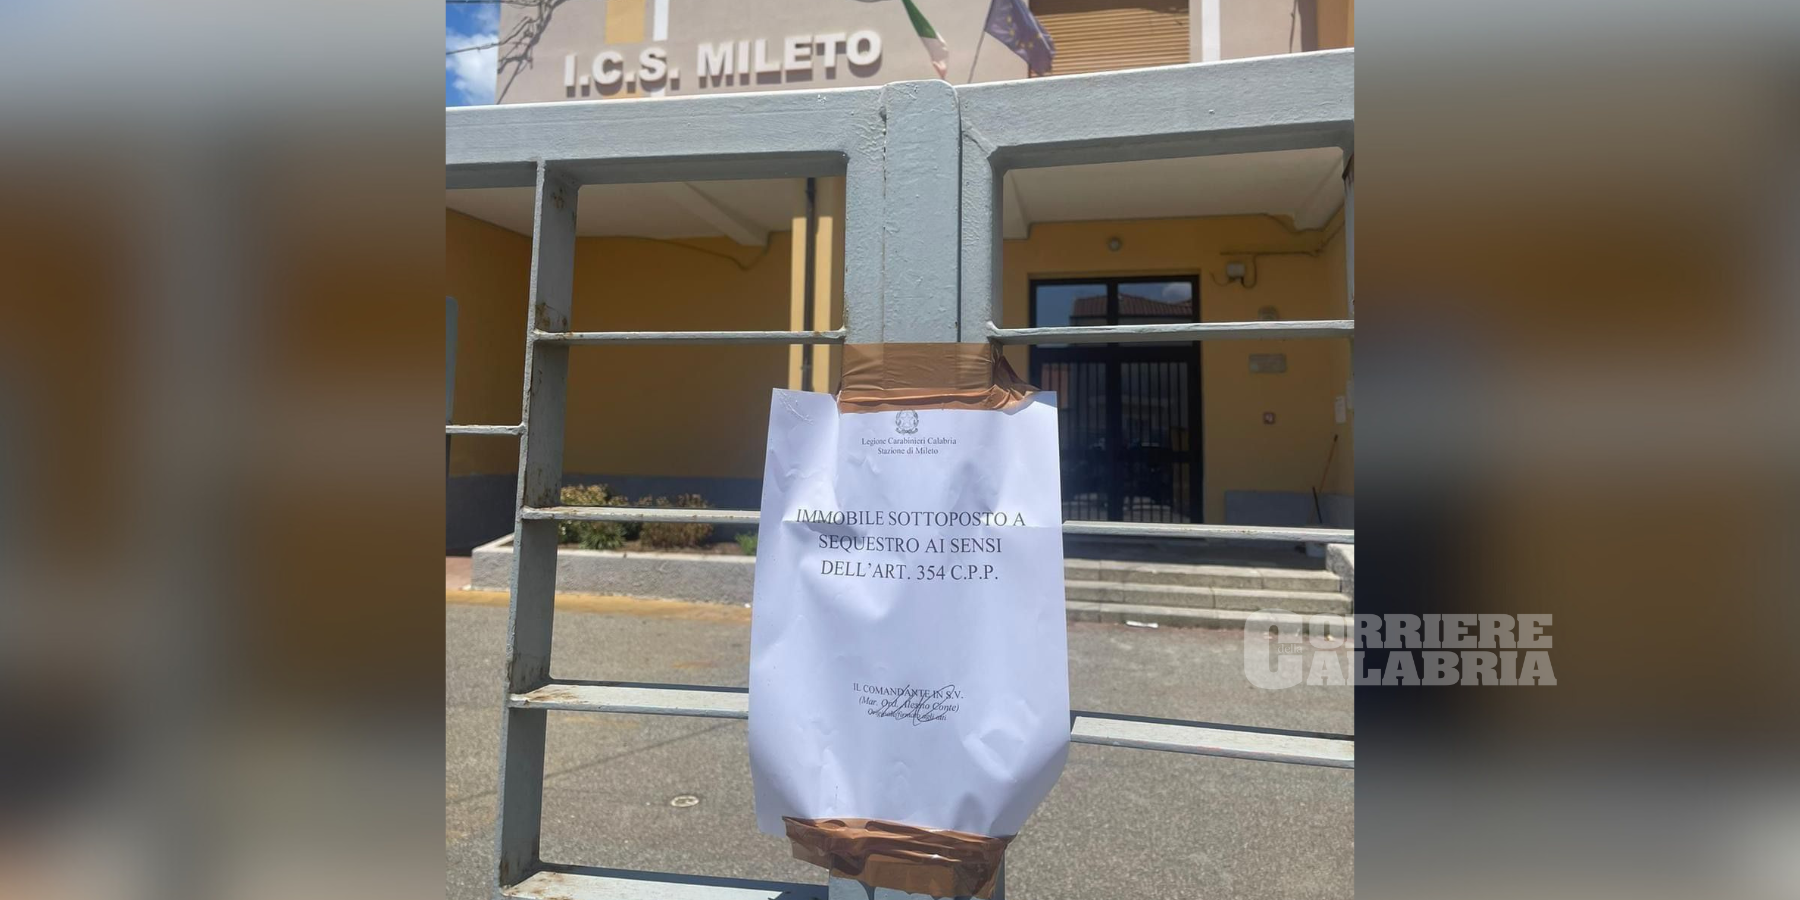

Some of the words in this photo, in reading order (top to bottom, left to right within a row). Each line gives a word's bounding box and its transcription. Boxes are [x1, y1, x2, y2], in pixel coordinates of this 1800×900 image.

[564, 47, 680, 87] I.C.S.
[697, 30, 882, 78] MILETO
[861, 437, 886, 446] Legione
[887, 437, 926, 445] Carabinieri
[927, 437, 957, 445] Calabria
[877, 447, 905, 455] Stazione
[906, 447, 914, 455] di
[915, 447, 939, 455] Mileto
[796, 508, 885, 526] IMMOBILE
[888, 510, 1008, 527] SOTTOPOSTO
[1012, 512, 1026, 527] A
[818, 534, 920, 553] SEQUESTRO
[924, 538, 945, 553] AI
[949, 538, 1002, 553] SENSI
[916, 564, 946, 580] 354
[950, 564, 999, 580] C.P.P.
[853, 682, 861, 692] IL
[863, 684, 931, 698] COMANDANTE
[932, 690, 943, 699] IN
[945, 690, 964, 699] S.V.
[858, 696, 878, 706] (Mar.
[880, 699, 899, 708] Ord.
[932, 702, 960, 713] Conte)
